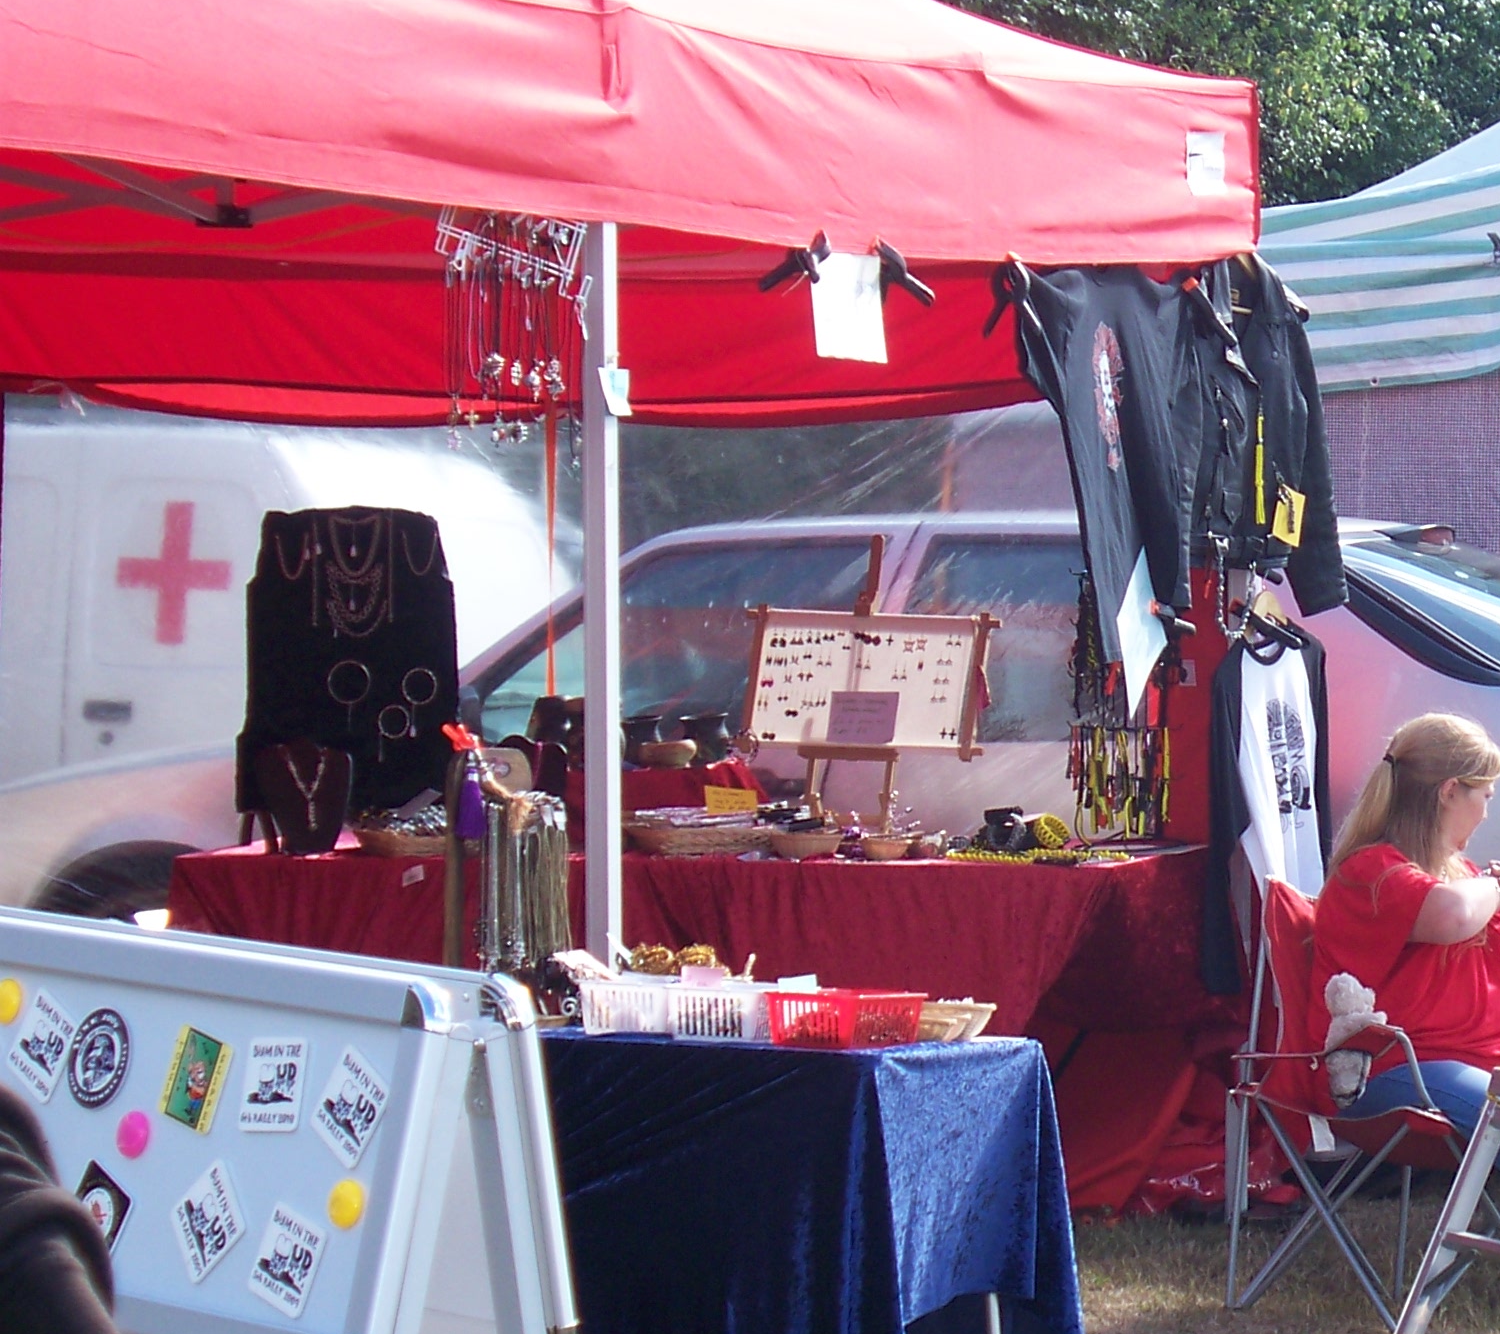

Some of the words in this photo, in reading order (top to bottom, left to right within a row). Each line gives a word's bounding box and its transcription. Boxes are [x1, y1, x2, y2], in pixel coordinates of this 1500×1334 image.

[253, 1045, 273, 1058] BUM
[274, 1045, 284, 1057] IN
[287, 1043, 302, 1057] THE
[276, 1062, 297, 1080] UD
[343, 1053, 361, 1080] BUM
[360, 1073, 372, 1089] IN
[369, 1083, 386, 1104] THE
[253, 1113, 277, 1124] RALLY
[356, 1093, 376, 1125] UD
[326, 1118, 344, 1139] RALLY
[210, 1167, 224, 1198] BUM
[273, 1209, 293, 1231] BUM
[291, 1223, 302, 1238] IN
[303, 1230, 320, 1246] THE
[292, 1243, 313, 1270] UD
[263, 1276, 283, 1295] RALLY
